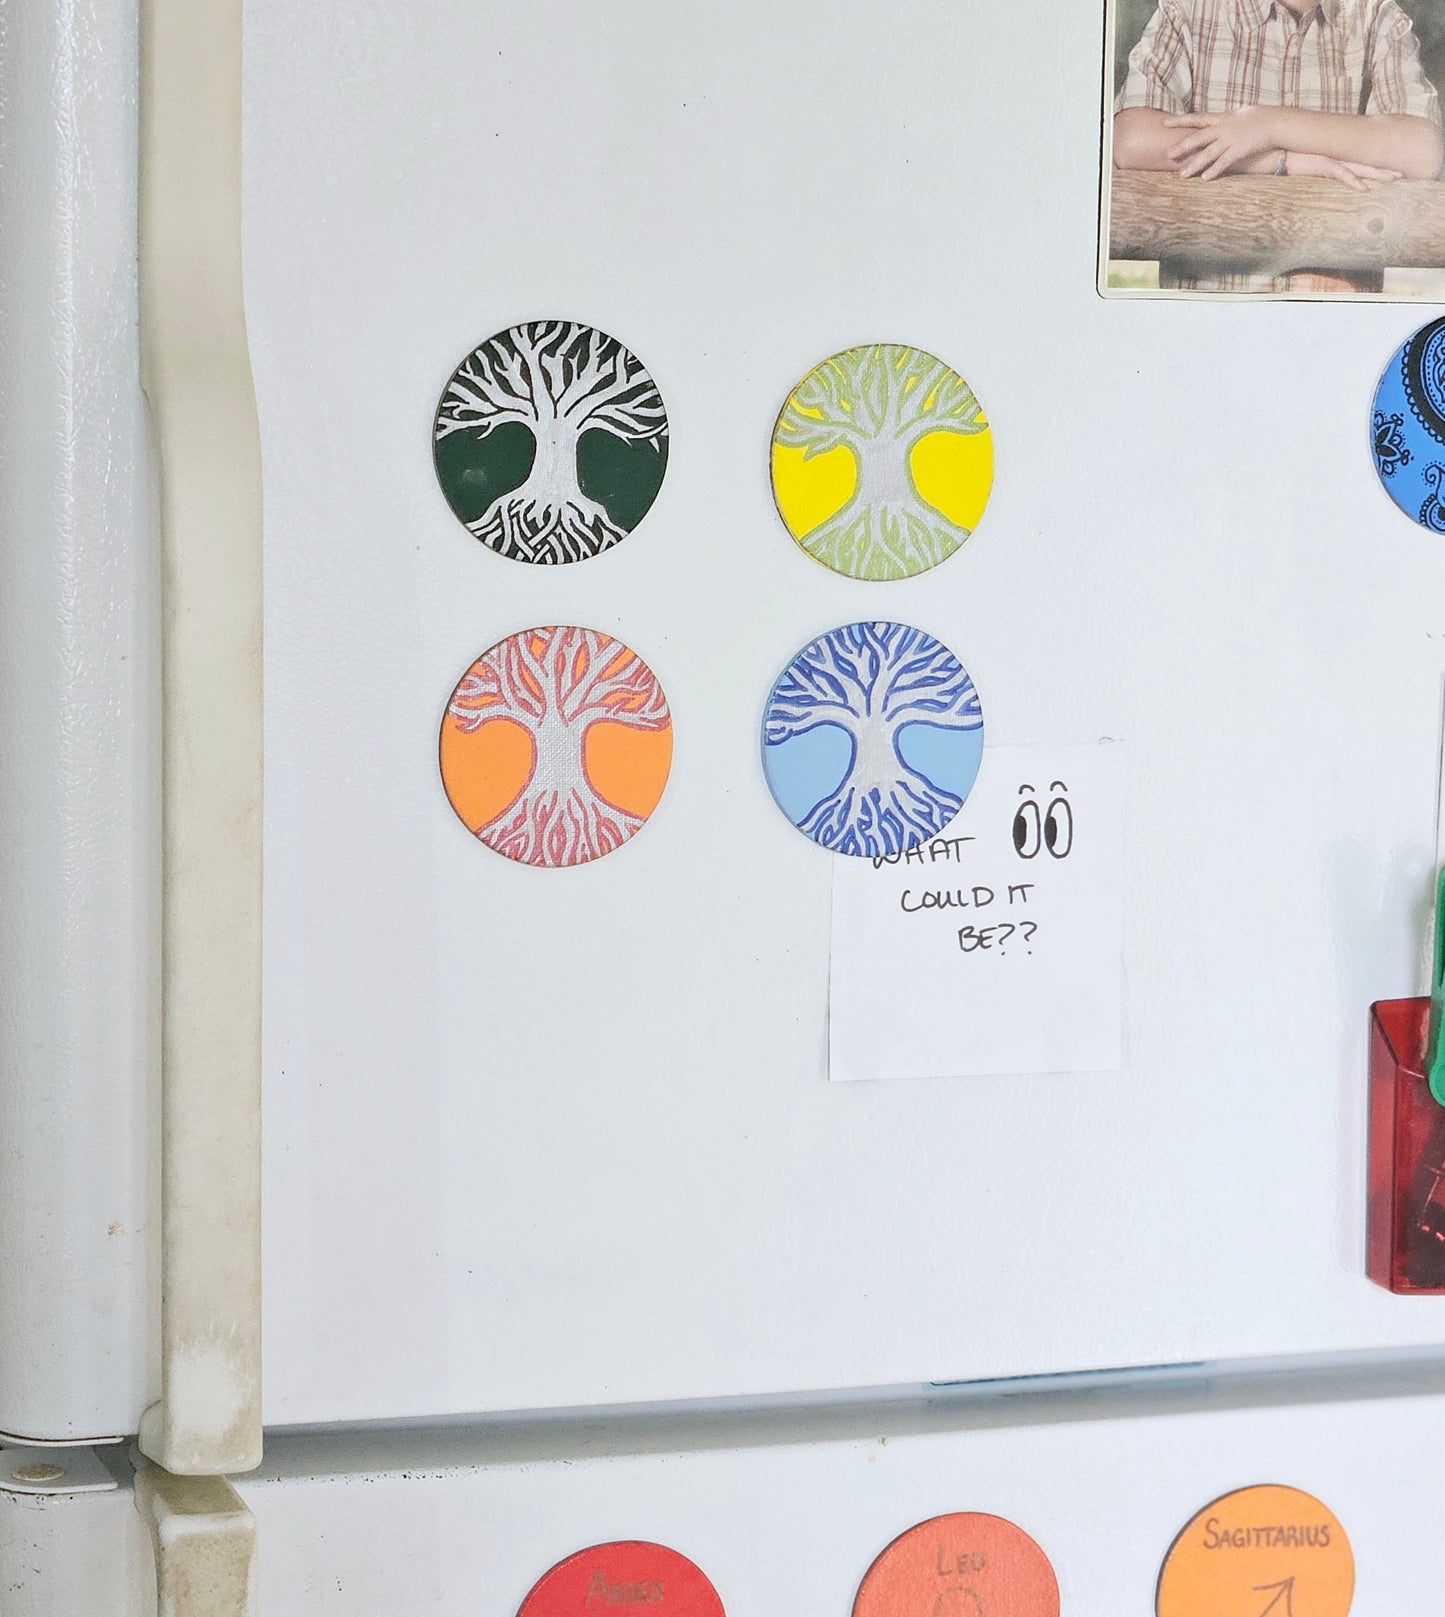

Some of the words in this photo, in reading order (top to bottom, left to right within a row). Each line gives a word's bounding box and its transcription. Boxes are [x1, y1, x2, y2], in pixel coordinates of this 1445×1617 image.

[900, 886, 995, 912] COULD
[1008, 884, 1035, 905] IT
[957, 921, 1038, 956] BE??
[1203, 1517, 1331, 1549] SAGITTARIUS
